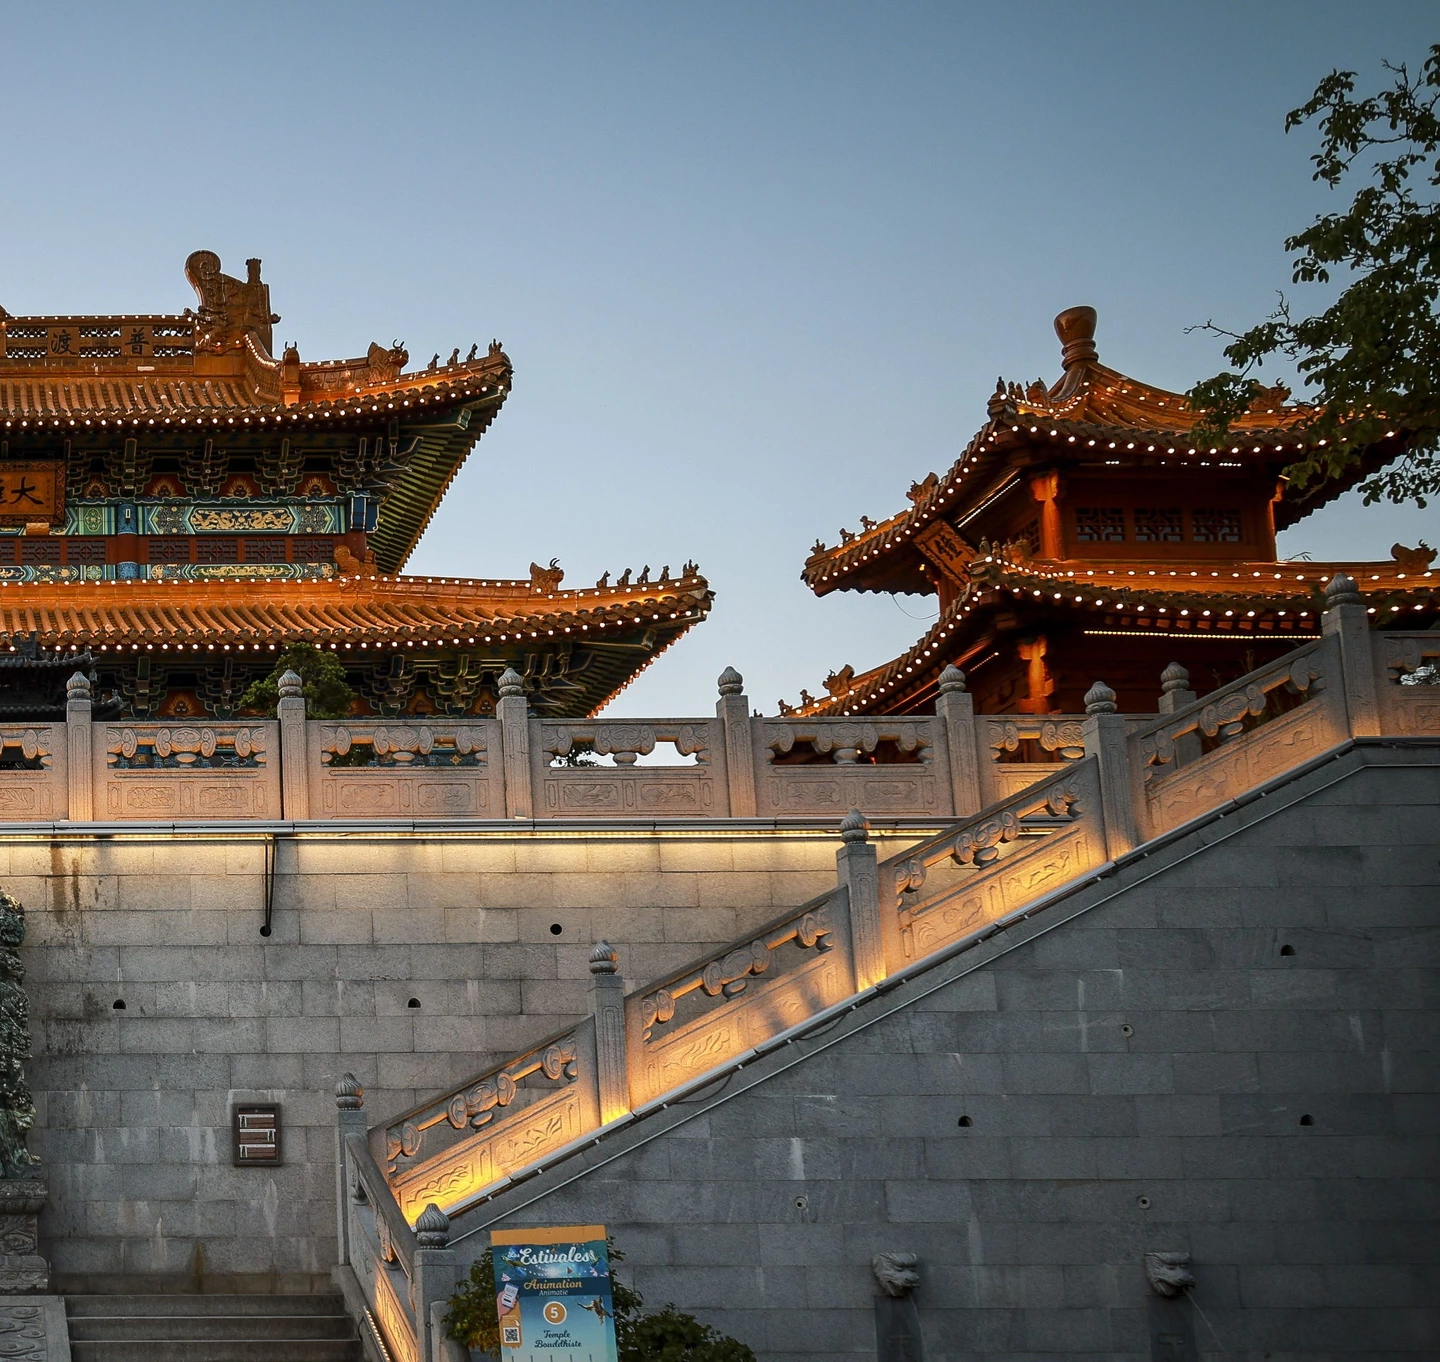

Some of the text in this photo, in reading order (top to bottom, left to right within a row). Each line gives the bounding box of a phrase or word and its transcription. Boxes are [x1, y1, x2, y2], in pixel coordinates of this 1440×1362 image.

[520, 1246, 590, 1265] Estivales
[523, 1278, 582, 1291] Animation
[550, 1307, 559, 1319] 5
[543, 1329, 570, 1340] Temple
[534, 1339, 582, 1349] Bouddhiste
